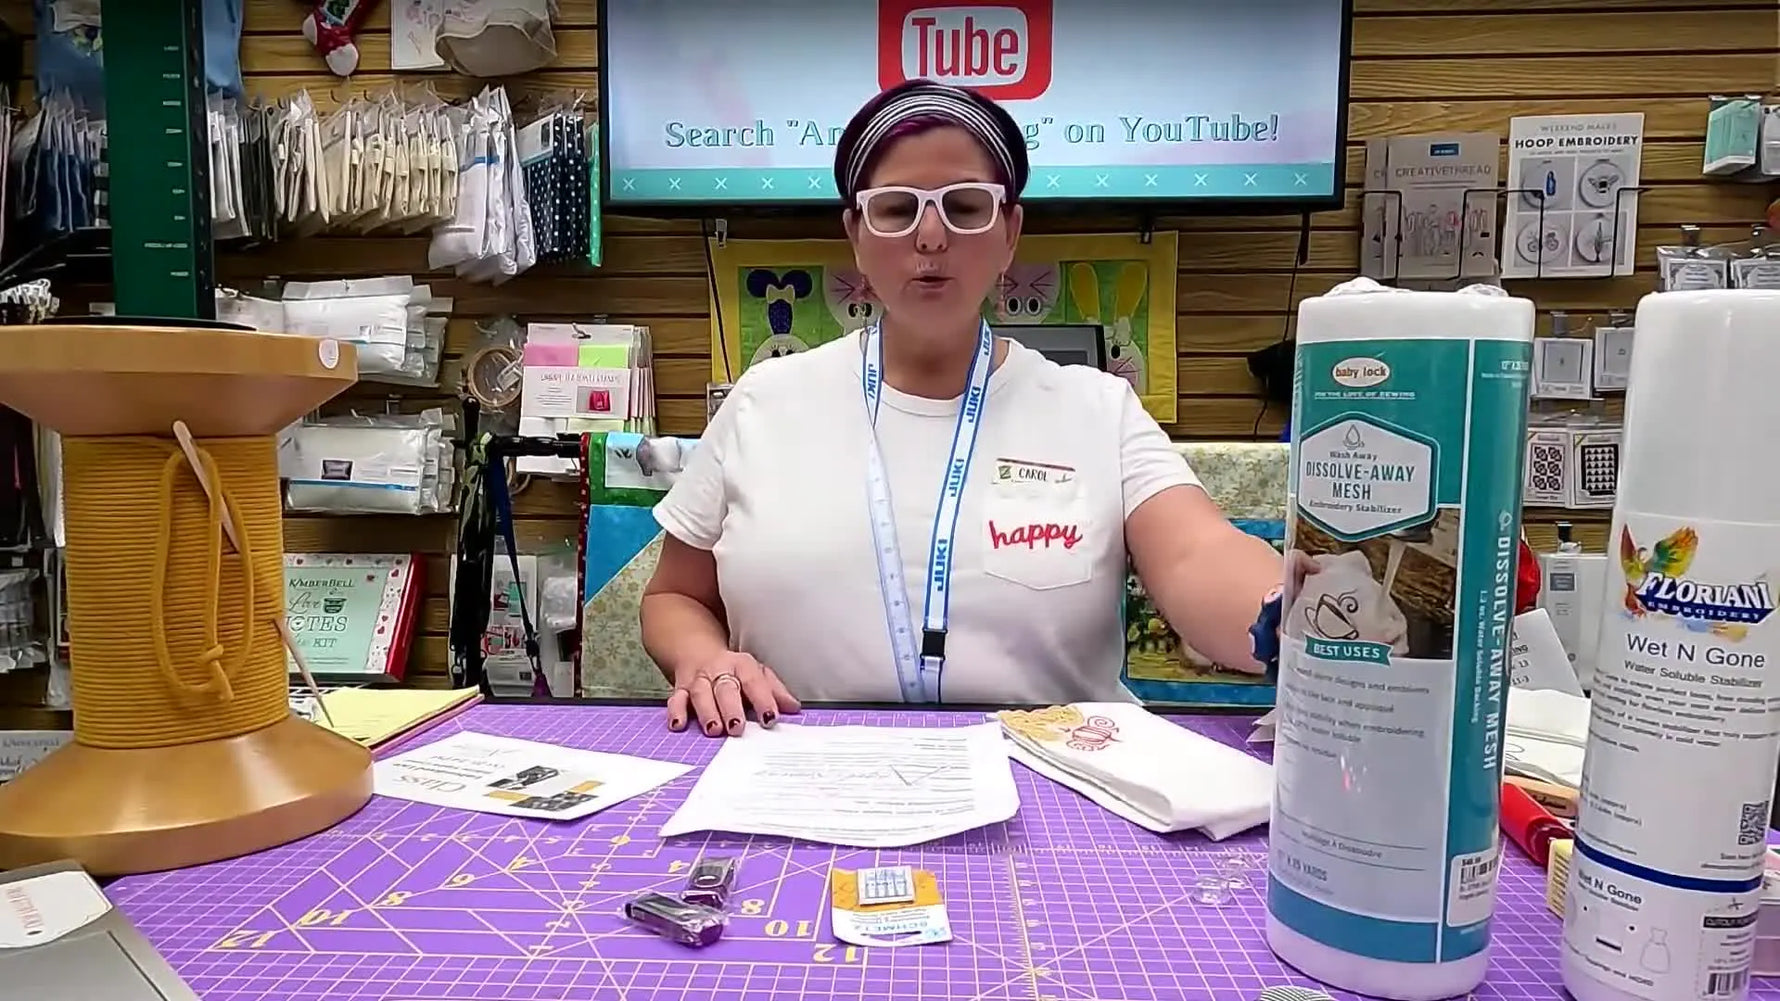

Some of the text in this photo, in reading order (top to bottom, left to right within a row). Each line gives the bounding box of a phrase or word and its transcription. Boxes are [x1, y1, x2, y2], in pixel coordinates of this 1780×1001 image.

[911, 16, 1019, 77] Tube
[665, 119, 774, 147] Search
[1065, 124, 1105, 143] on
[1120, 113, 1279, 143] YouTube!
[1515, 135, 1638, 149] HOOP EMBROIDERY
[867, 363, 877, 399] JUKI
[1335, 366, 1386, 378] baby lock
[966, 386, 981, 423] JUKI
[1353, 452, 1378, 462] Away
[950, 458, 965, 497] JUKI
[1019, 467, 1047, 481] CAROL
[1306, 461, 1415, 482] DISSOLVE-AWAY
[1332, 481, 1371, 500] MESH
[1356, 503, 1402, 514] Stabilizer
[989, 520, 1083, 549] happy
[934, 538, 948, 592] JUKI
[1635, 571, 1774, 609] FLORIANI
[1647, 600, 1761, 621] EMBROIDERY
[1313, 643, 1380, 658] BEST USES
[1482, 536, 1510, 770] DISSOLVE-AWAY MESH
[1626, 633, 1766, 668] Wet N Gone
[1624, 660, 1655, 675] Water
[1660, 667, 1706, 685] Soluble
[1594, 878, 1604, 890] N
[1607, 884, 1642, 905] Gone
[299, 909, 352, 926] 10
[741, 899, 765, 915] 8
[765, 920, 812, 937] 10
[219, 930, 276, 949] 12
[813, 943, 860, 963] 12
